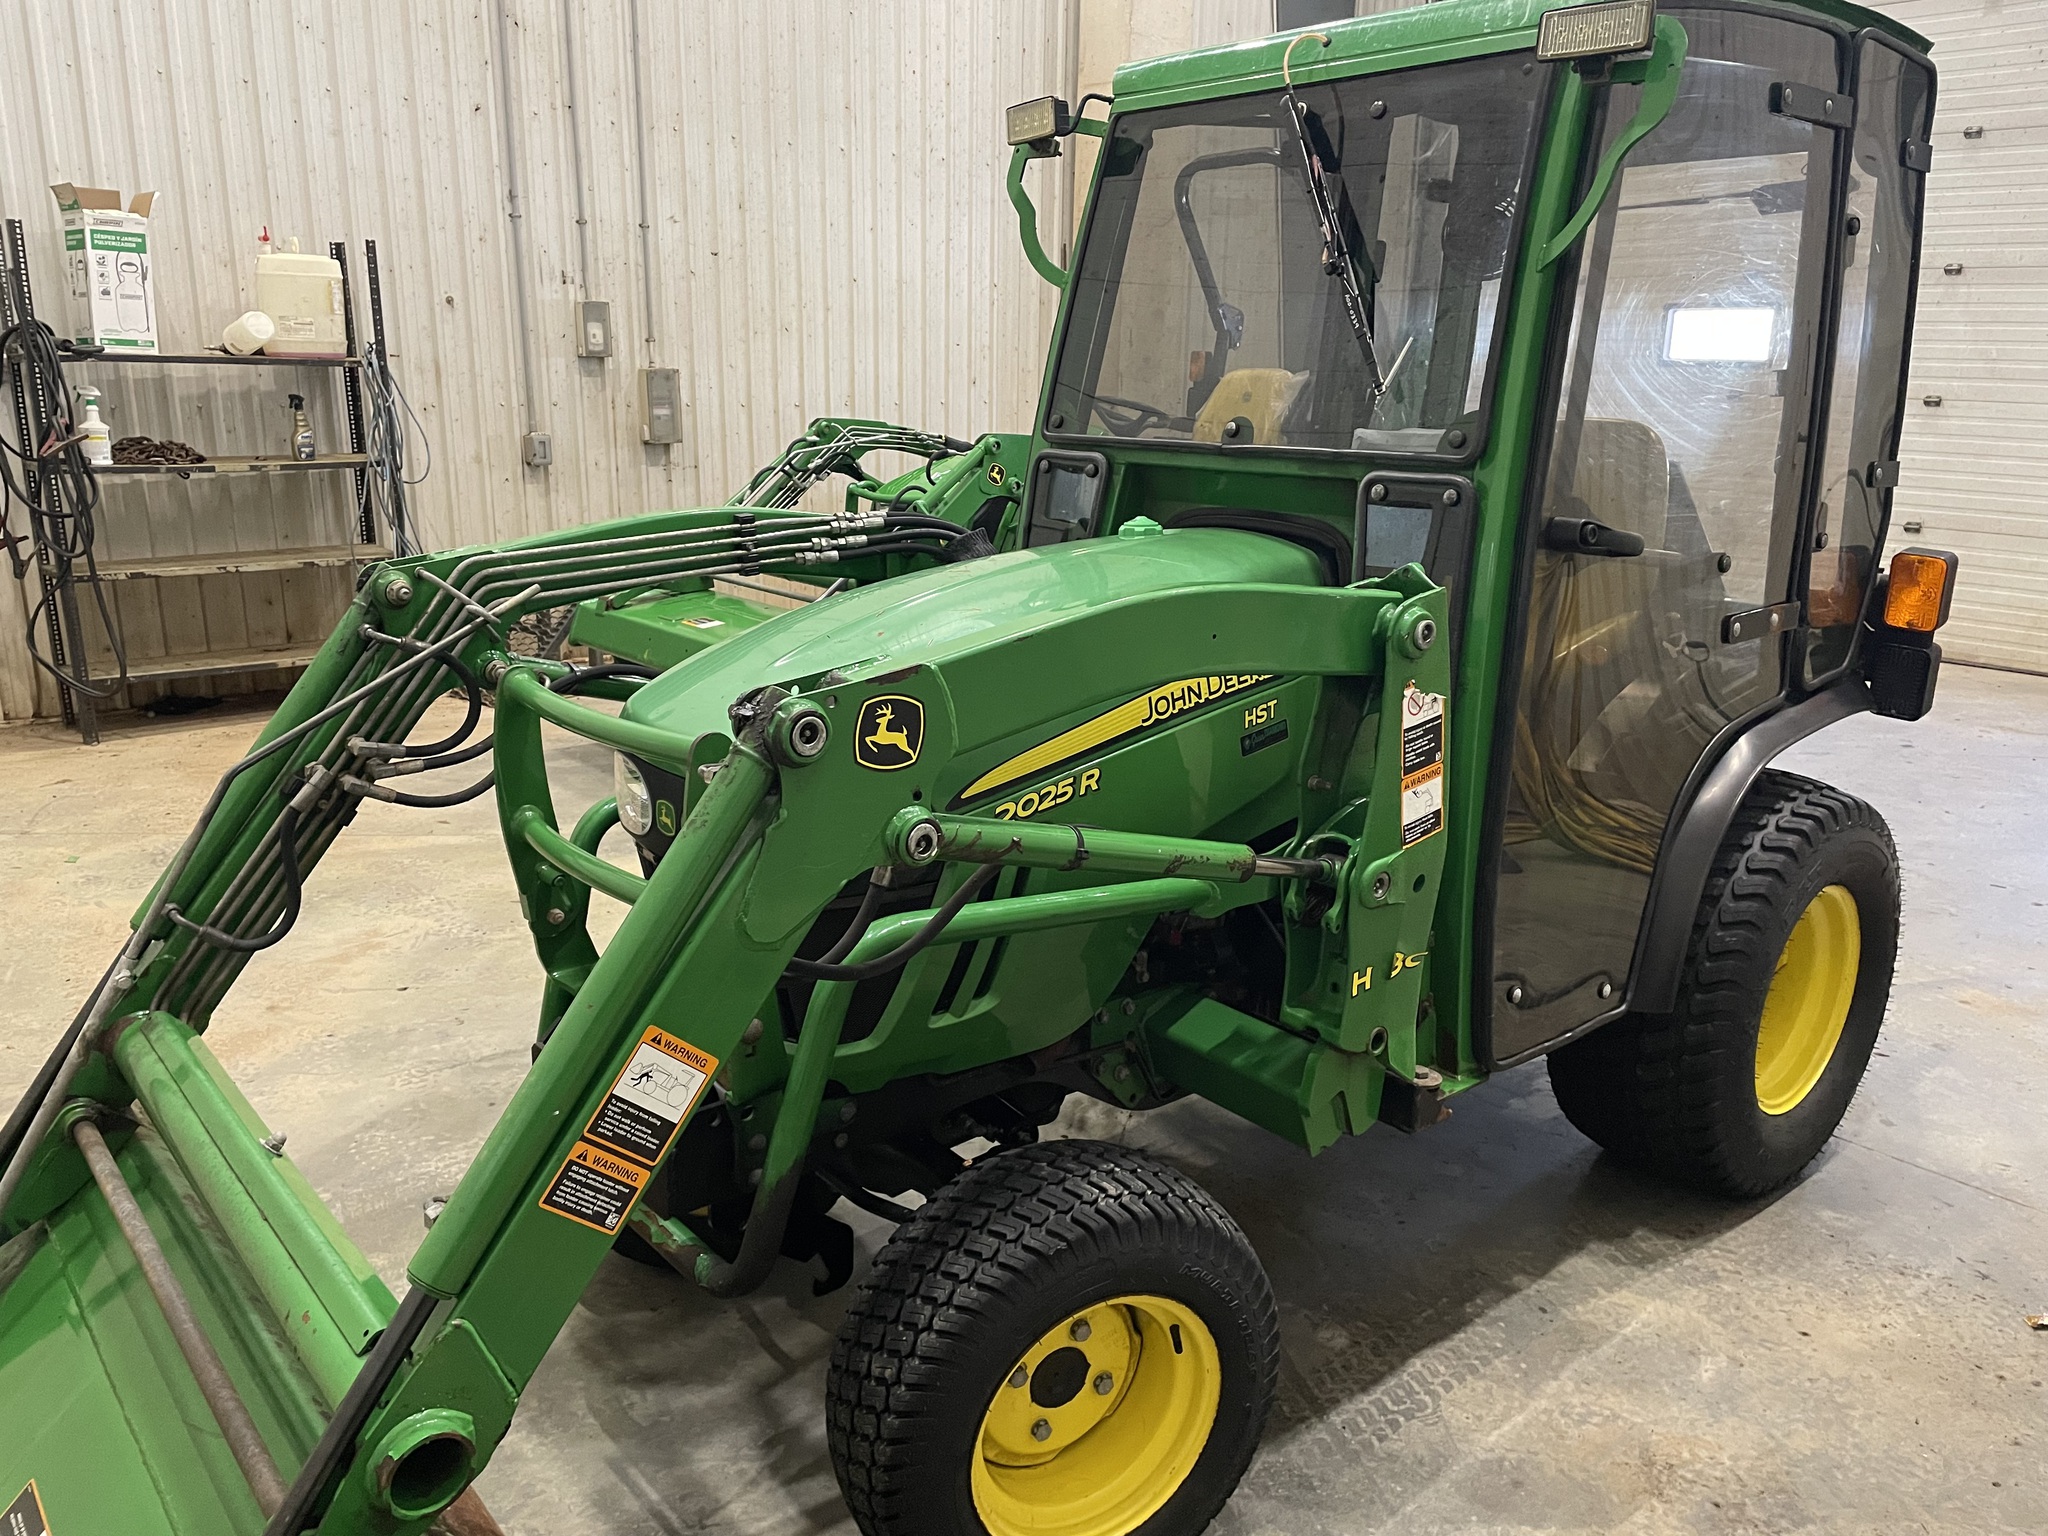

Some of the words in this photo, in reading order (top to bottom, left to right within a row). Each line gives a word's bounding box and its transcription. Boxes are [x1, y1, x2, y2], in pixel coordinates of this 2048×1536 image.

[1141, 681, 1205, 727] JOHN
[1244, 700, 1279, 729] HST
[1409, 767, 1442, 788] WARNING
[995, 777, 1074, 822] 2025
[1079, 768, 1103, 797] R
[663, 1039, 708, 1069] WARNING
[592, 1155, 640, 1182] WARNING
